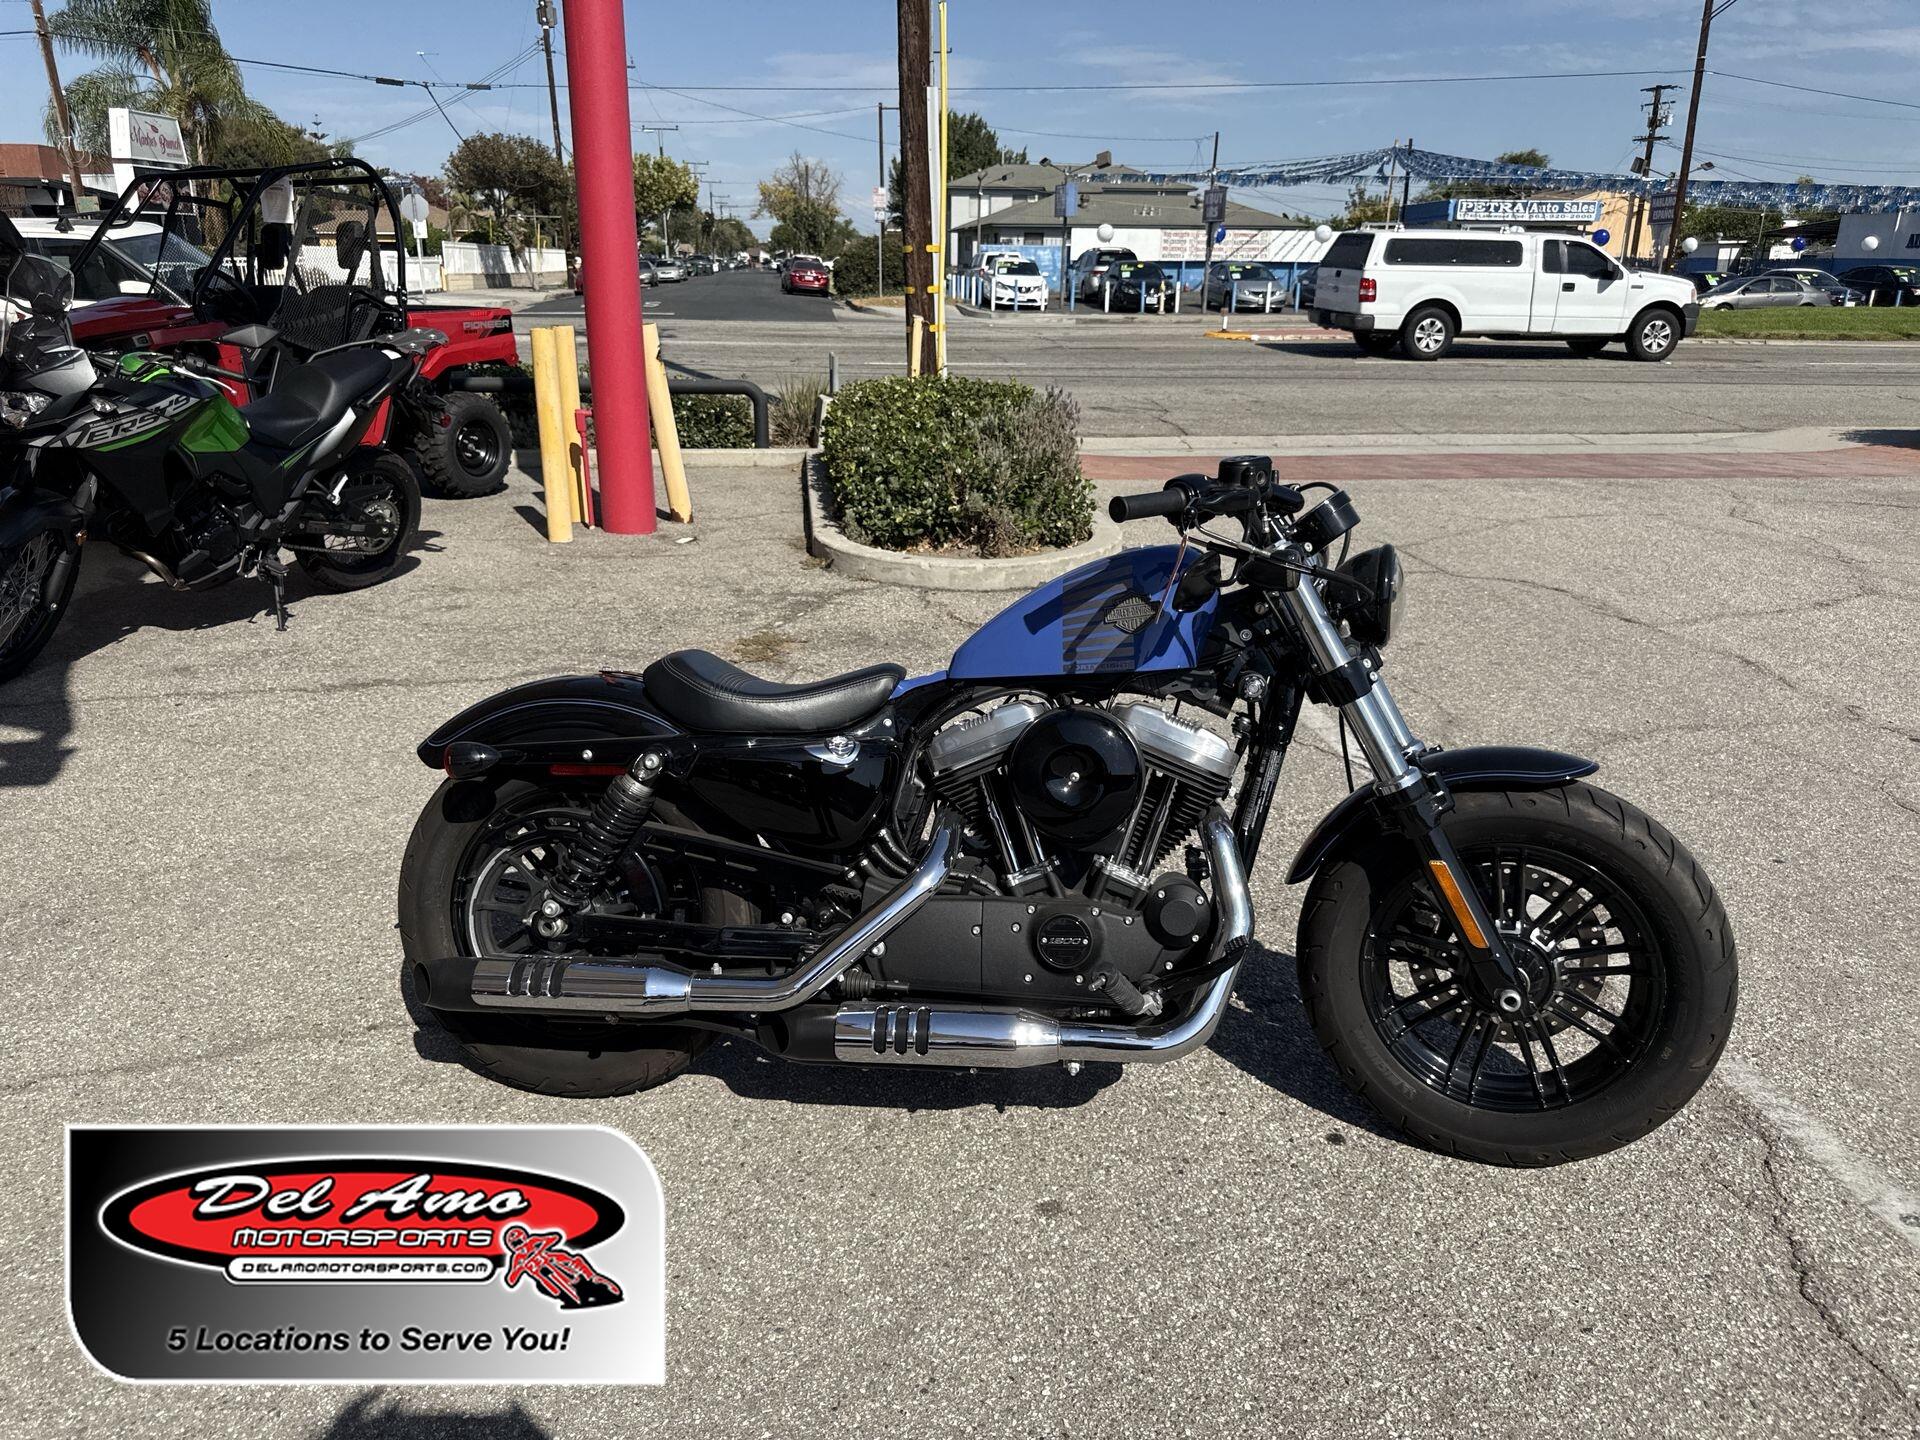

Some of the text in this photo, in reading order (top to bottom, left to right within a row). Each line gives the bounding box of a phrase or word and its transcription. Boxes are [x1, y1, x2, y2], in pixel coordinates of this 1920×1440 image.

[1460, 201, 1595, 213] PETRA Auto Sales
[463, 319, 509, 330] PIONEER
[60, 393, 191, 448] VERSYS
